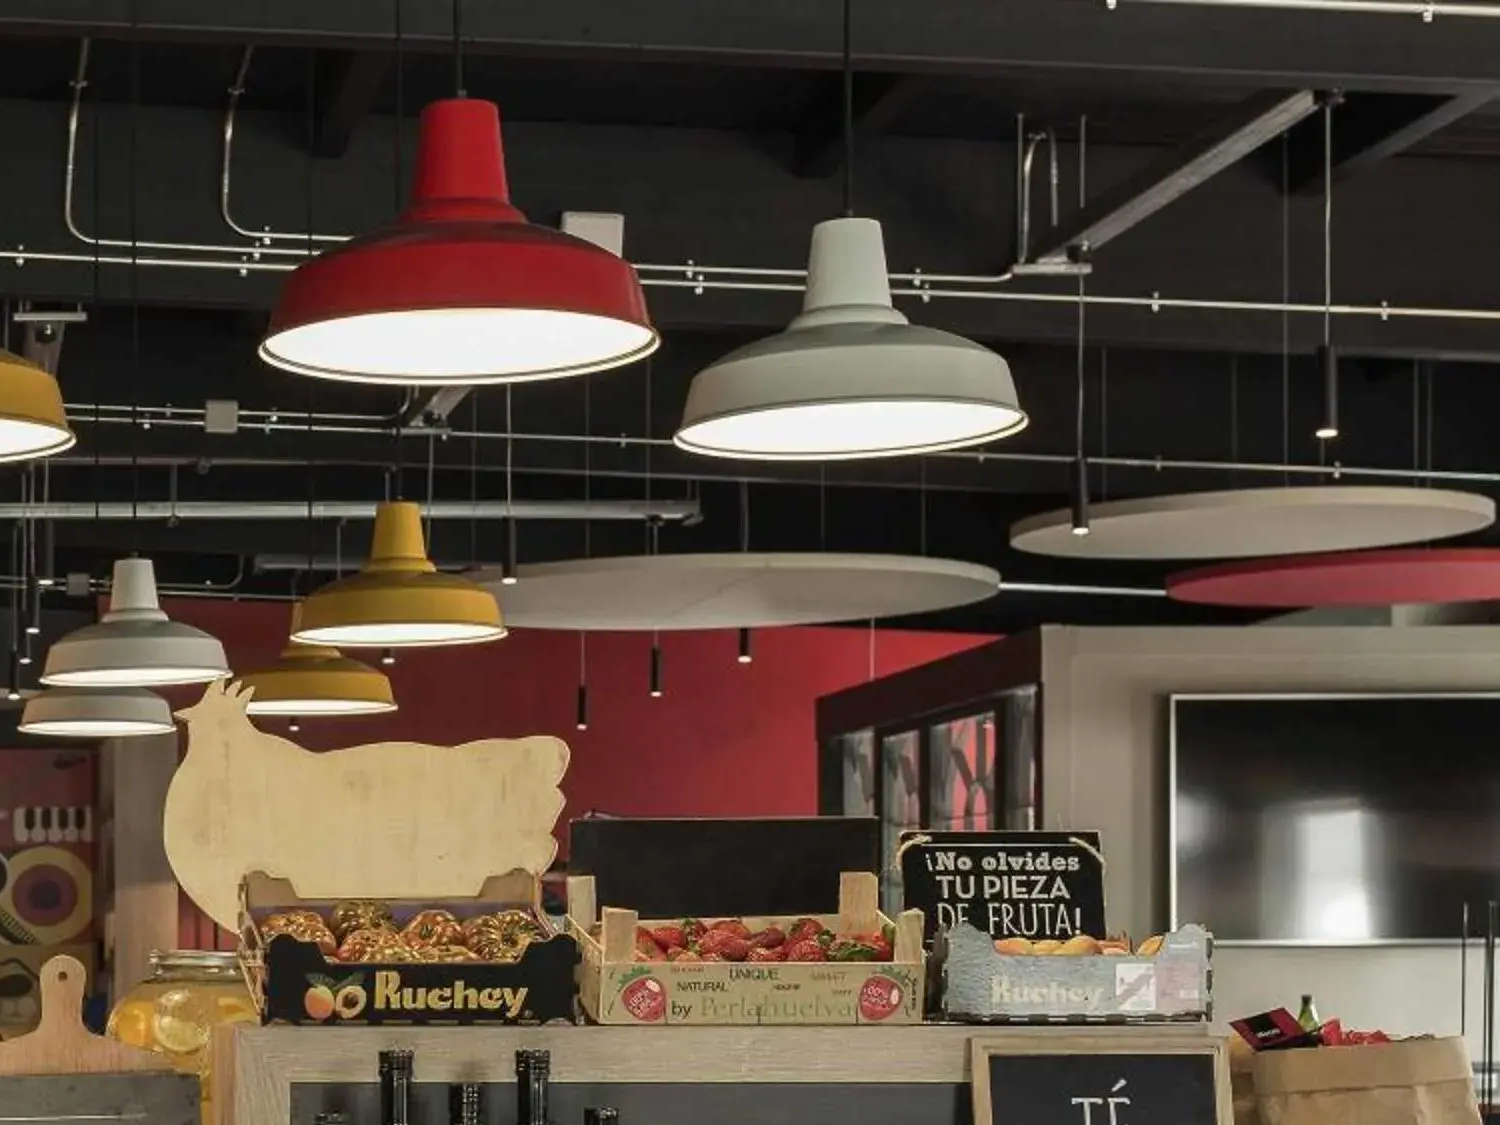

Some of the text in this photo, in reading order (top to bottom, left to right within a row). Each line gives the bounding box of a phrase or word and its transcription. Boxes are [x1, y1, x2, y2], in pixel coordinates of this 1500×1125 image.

[982, 851, 1080, 872] olvides
[935, 875, 1071, 900] TU PIEZA
[937, 902, 1082, 935] DE FRUTA!
[729, 968, 780, 981] UNIQUE
[374, 970, 529, 1018] Ruchey
[676, 981, 729, 992] NATURAL
[671, 999, 692, 1017] by
